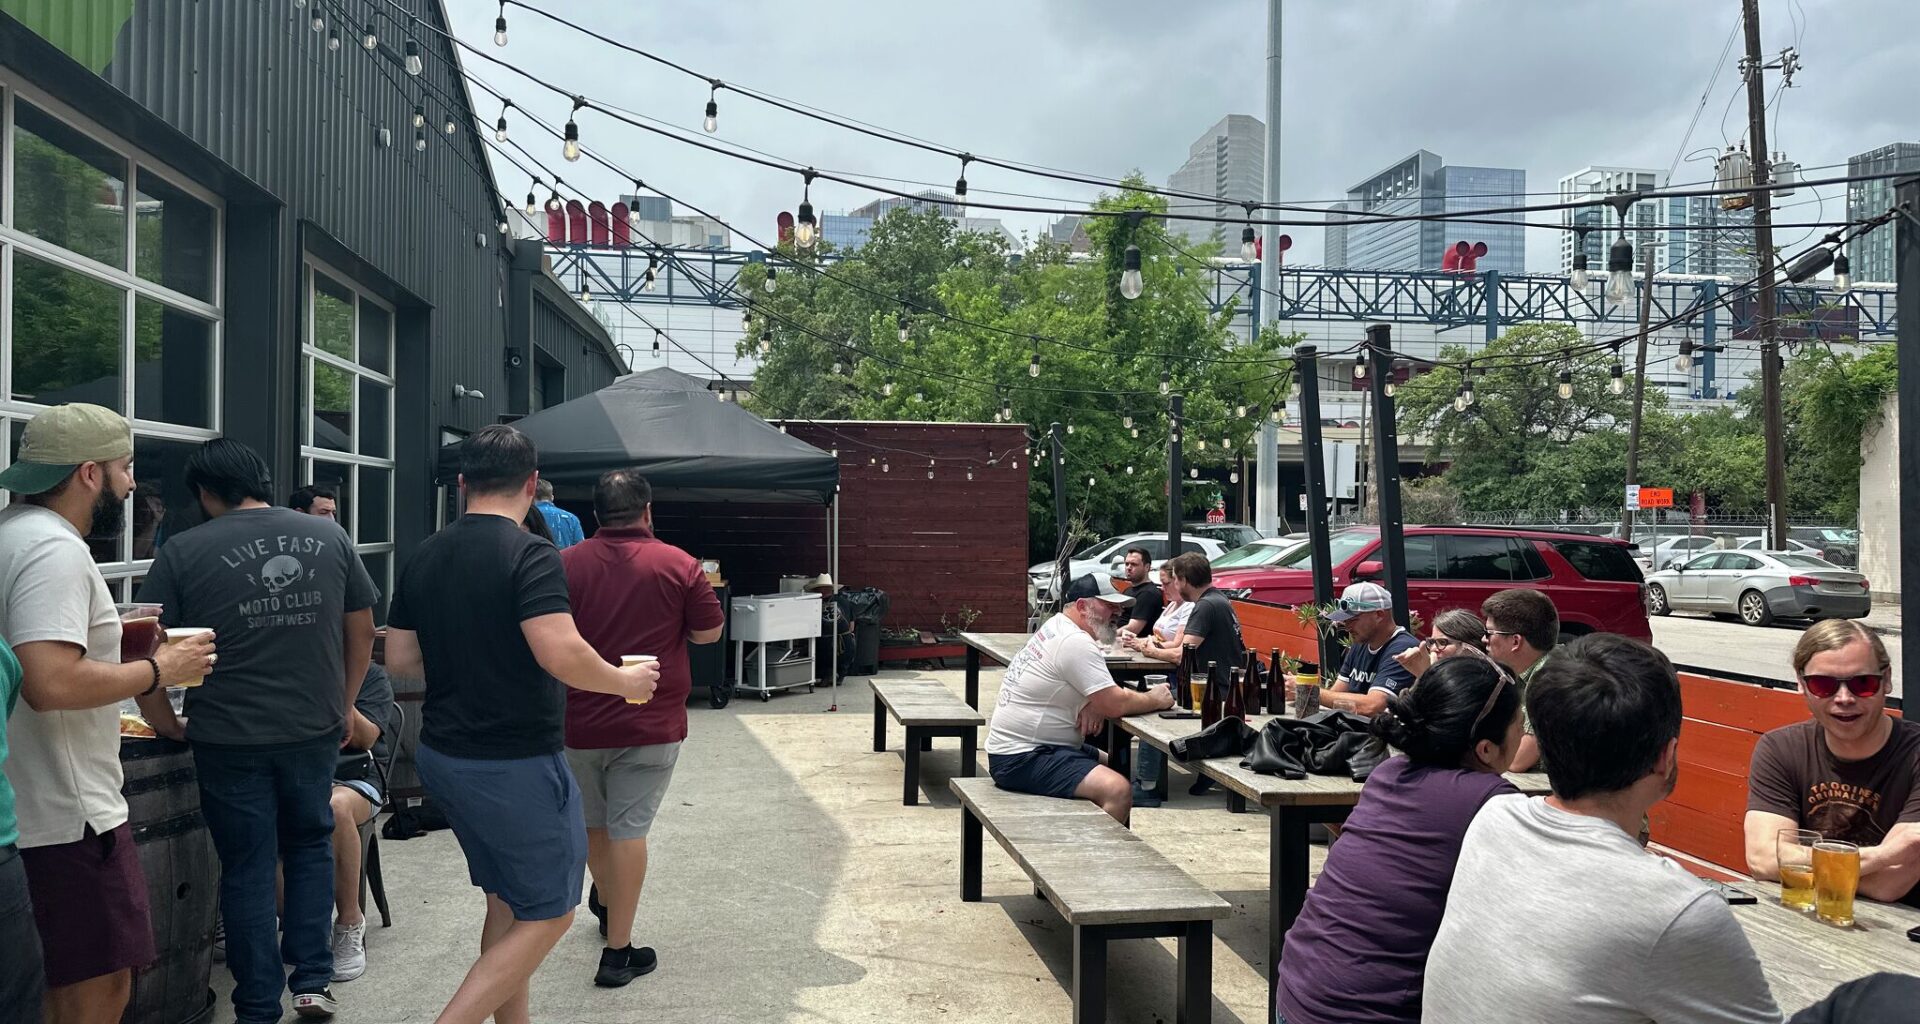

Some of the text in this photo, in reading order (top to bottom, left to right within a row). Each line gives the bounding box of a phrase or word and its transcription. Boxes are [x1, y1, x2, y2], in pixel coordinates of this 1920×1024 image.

[1208, 515, 1225, 524] STOP
[221, 535, 326, 569] LIVE FAST
[239, 591, 322, 617] MOTO CLUB
[247, 612, 318, 628] SOUTHWEST
